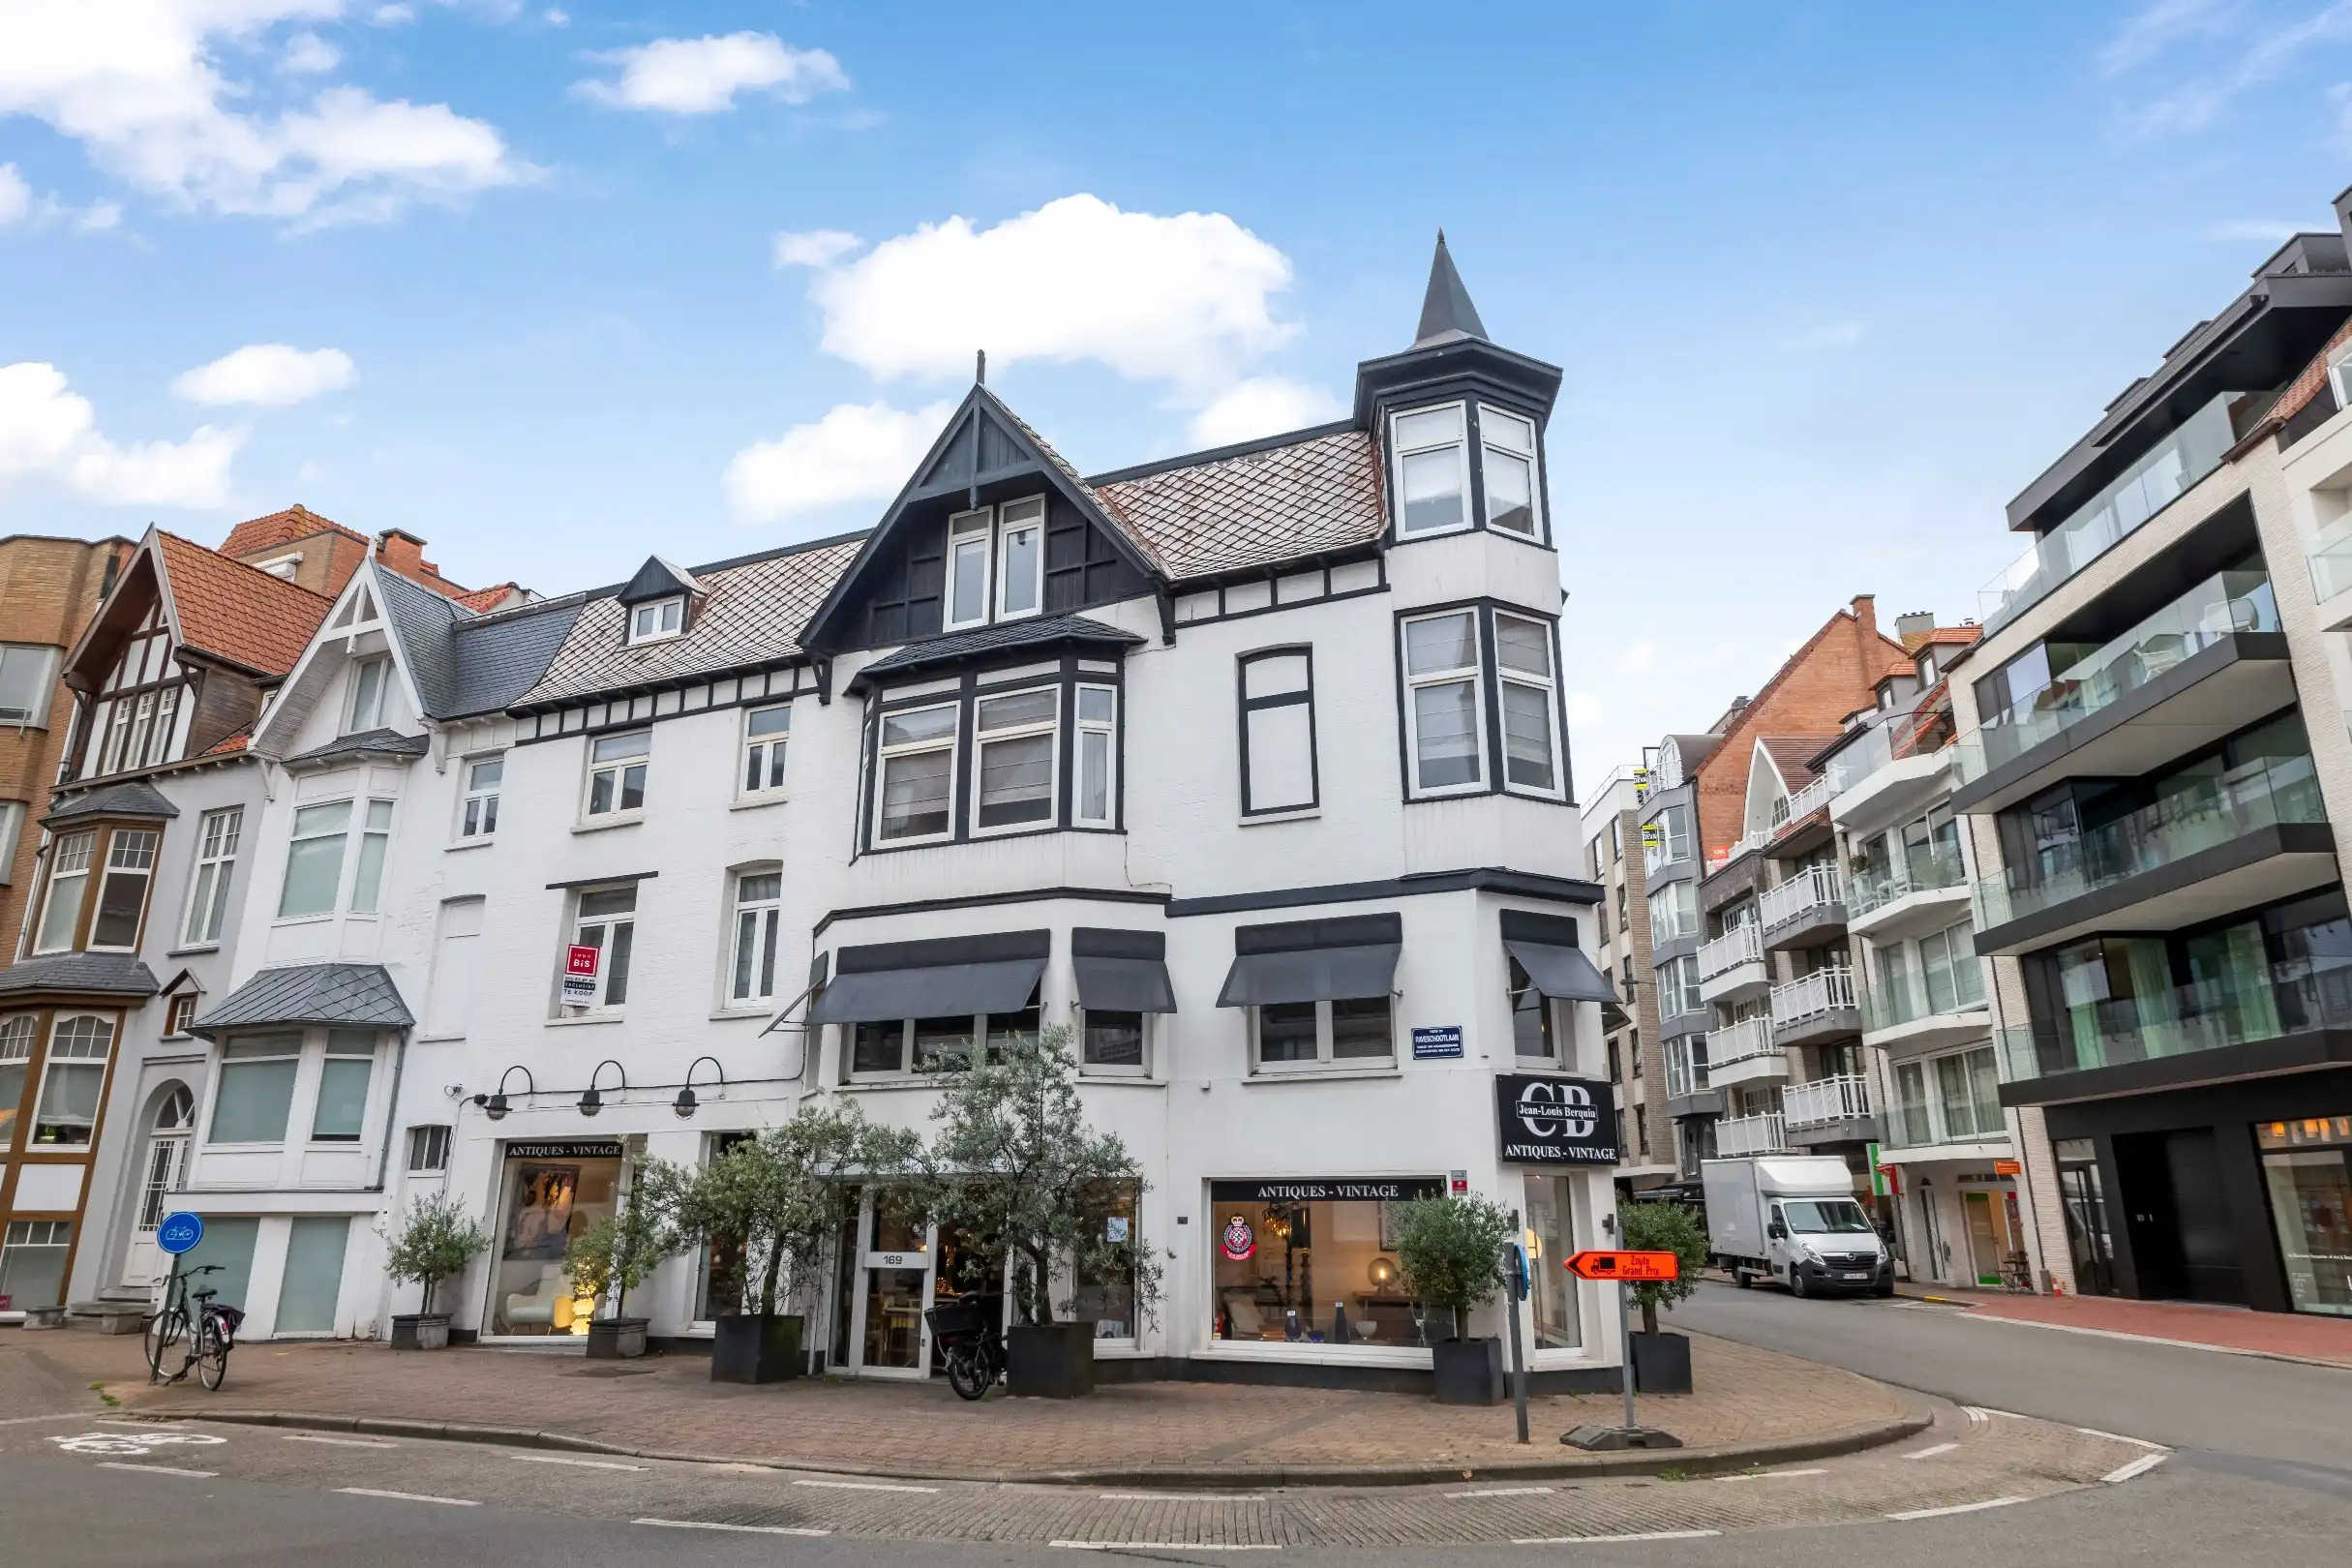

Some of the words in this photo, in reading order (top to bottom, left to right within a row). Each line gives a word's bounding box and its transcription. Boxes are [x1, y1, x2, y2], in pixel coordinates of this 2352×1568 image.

[1519, 1104, 1563, 1117] Jean-Louis
[1564, 1106, 1597, 1120] Berquin
[509, 1146, 564, 1158] ANTIQUES
[573, 1145, 620, 1155] VINTAGE
[1505, 1144, 1561, 1160] ANTIQUES
[1568, 1146, 1616, 1160] VINTAGE
[1258, 1186, 1326, 1199] ANTIQUES
[1338, 1185, 1399, 1197] VINTAGE
[883, 1255, 903, 1265] 169
[1630, 1255, 1650, 1266] Zoute
[1622, 1265, 1643, 1276] Grand
[1645, 1267, 1659, 1276] Prix
